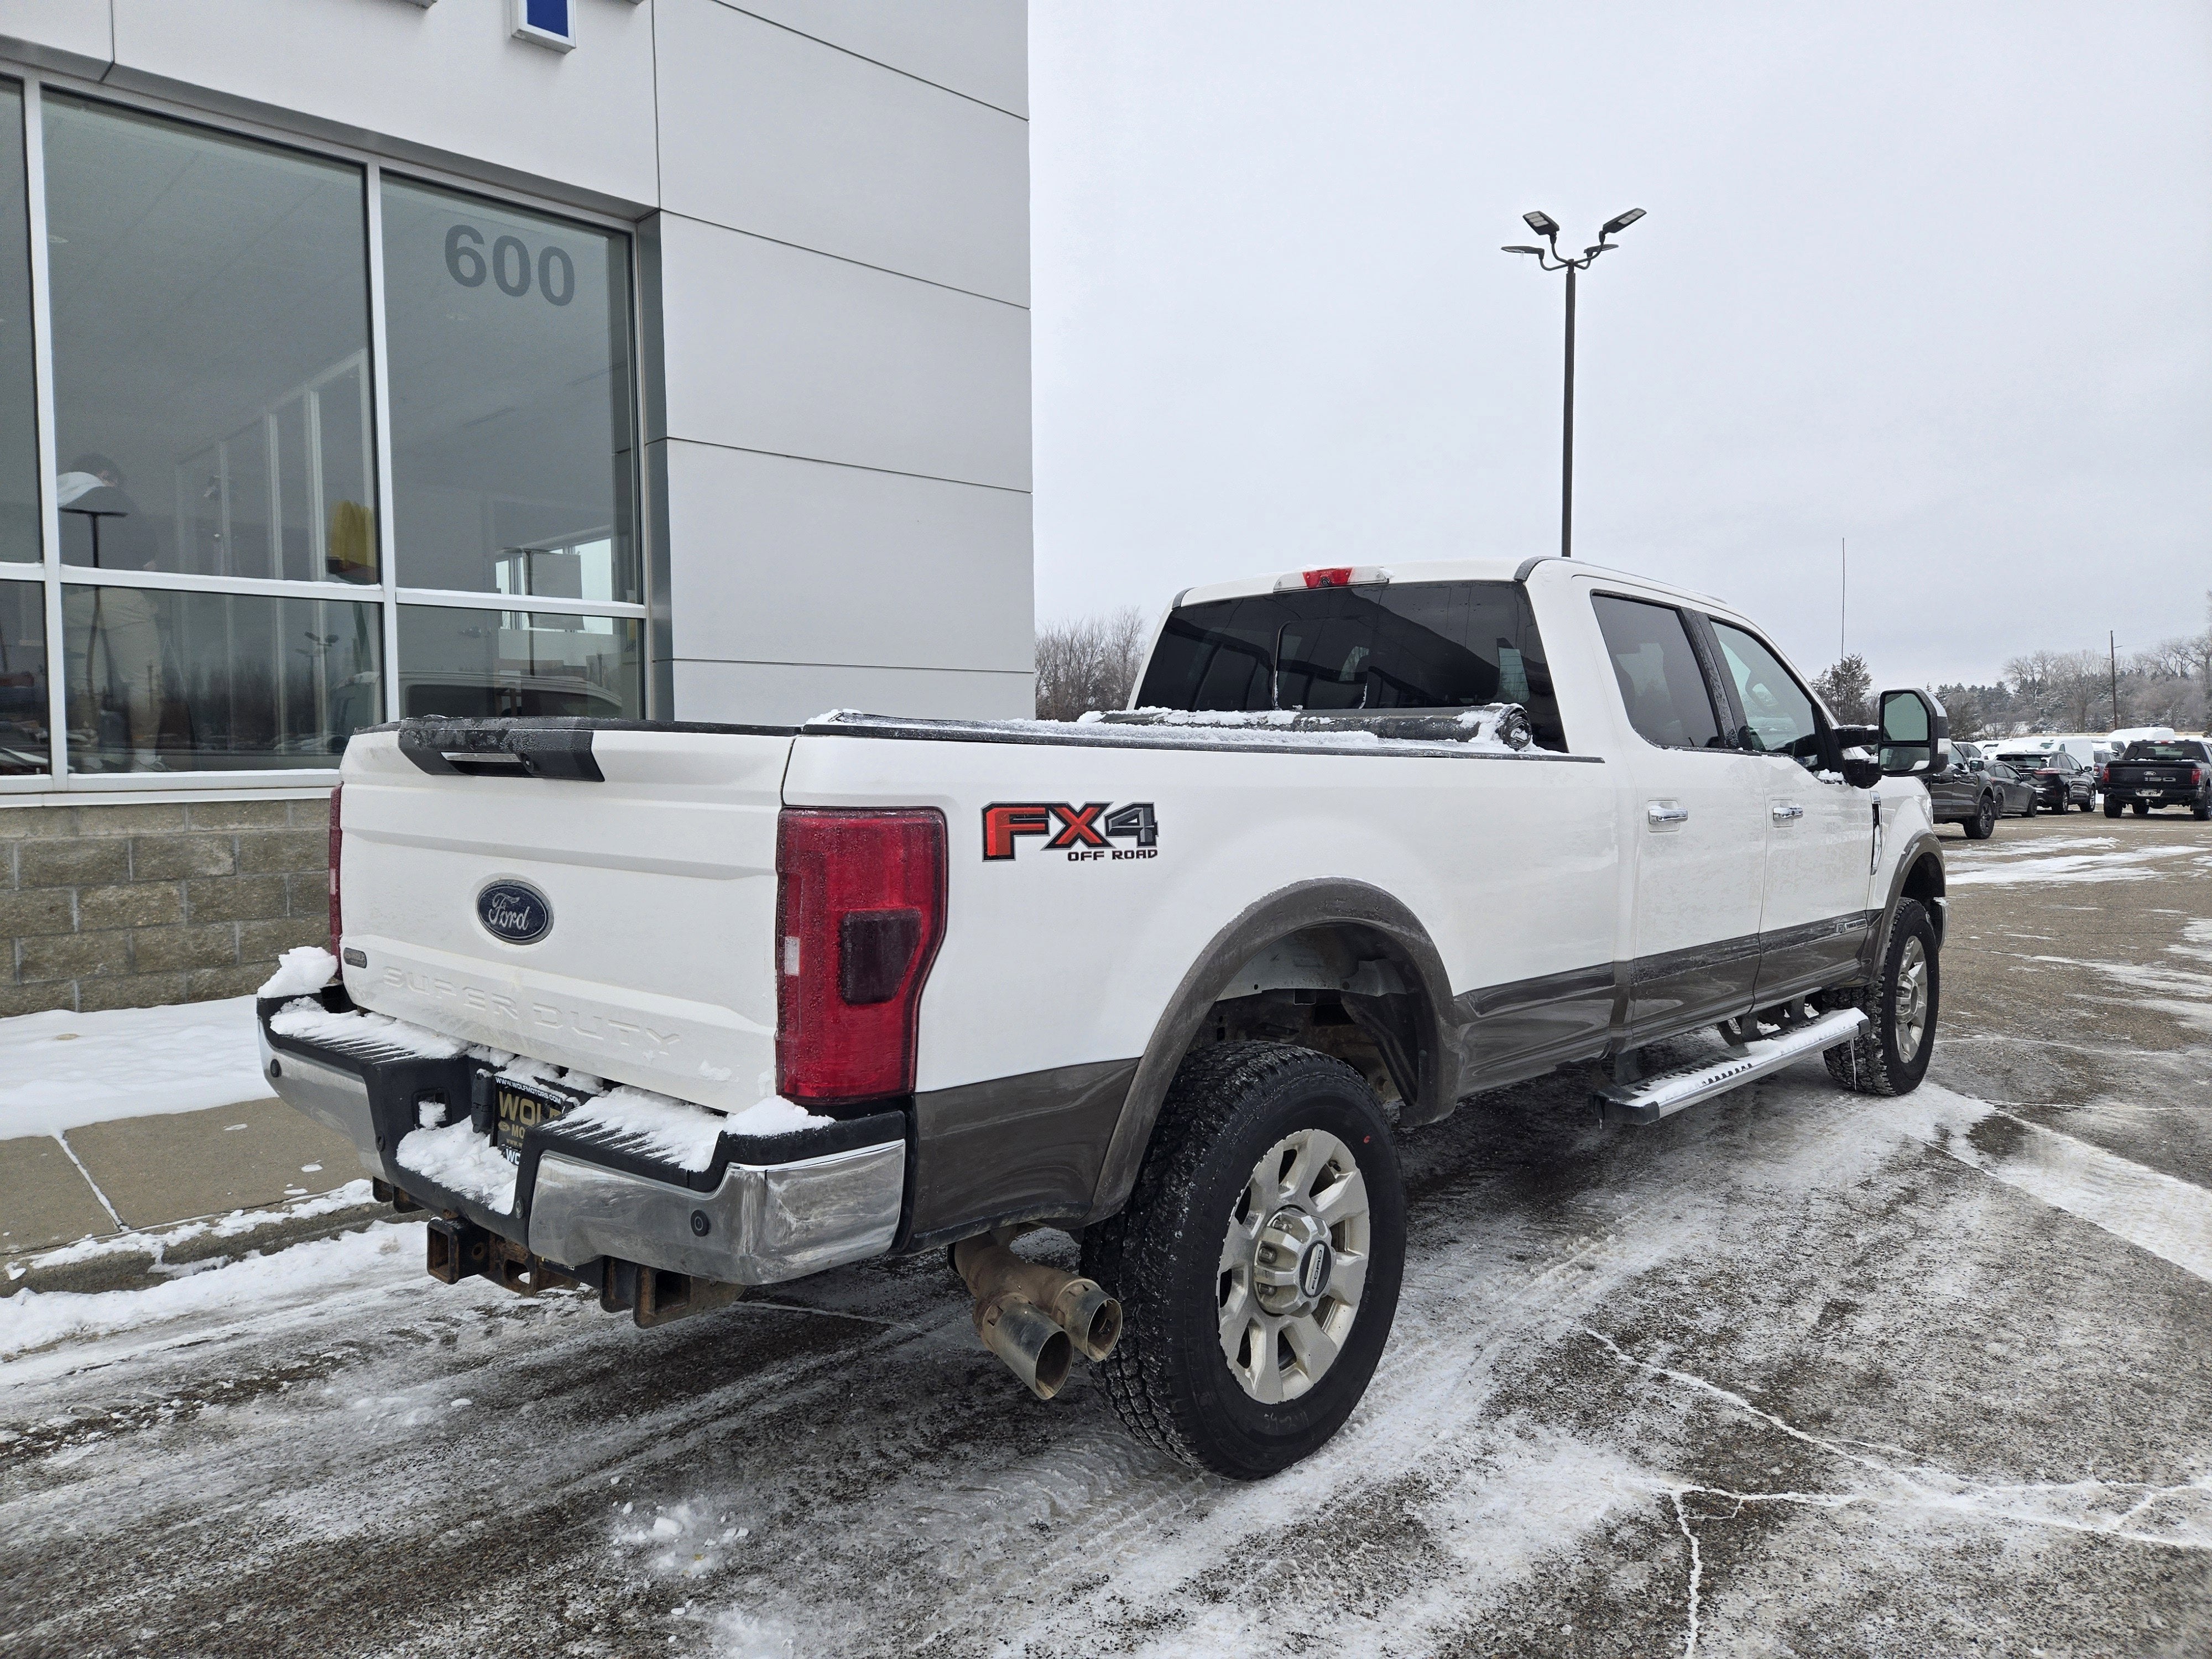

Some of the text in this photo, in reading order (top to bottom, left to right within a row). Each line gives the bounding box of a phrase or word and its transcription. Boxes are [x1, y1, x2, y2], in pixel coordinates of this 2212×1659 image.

[445, 225, 575, 306] 600
[981, 801, 1159, 862] FX4
[1067, 849, 1158, 862] OFF ROAD
[488, 893, 530, 930] Ford
[383, 966, 680, 1056] SUPER DUTY
[495, 1077, 561, 1105] WWW.WOLFMOTORSCOM
[1311, 1249, 1322, 1290] FORD
